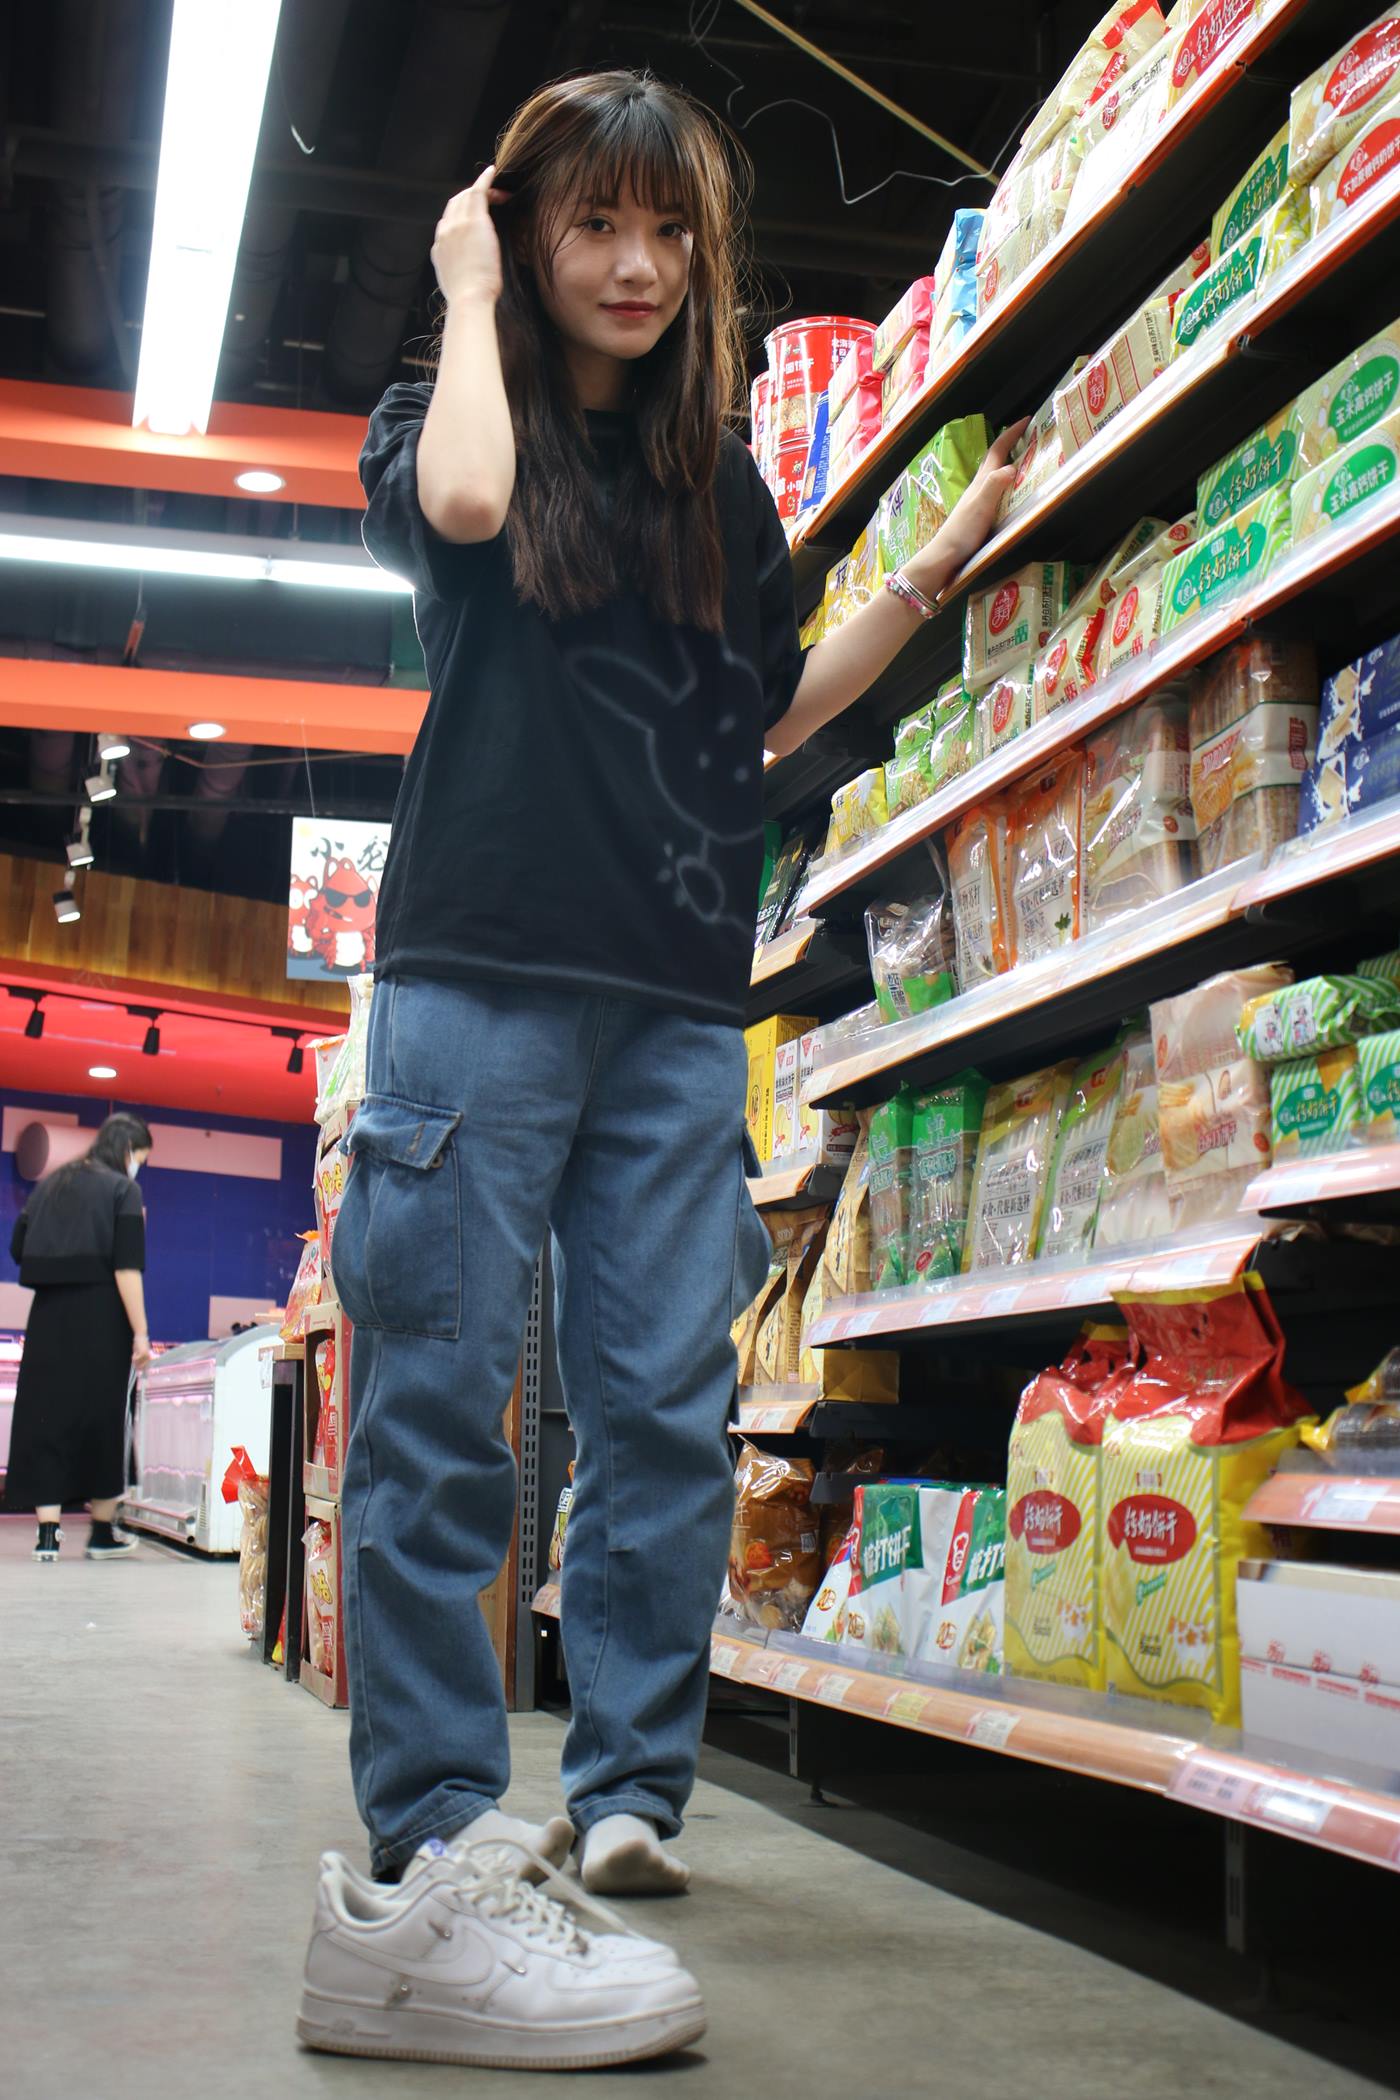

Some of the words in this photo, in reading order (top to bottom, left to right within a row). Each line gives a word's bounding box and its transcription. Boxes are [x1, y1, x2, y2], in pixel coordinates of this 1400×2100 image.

[1202, 252, 1256, 318] 钙奶饼干
[1336, 370, 1394, 427] 玉米高钙饼干
[1229, 442, 1283, 505] 钙奶饼干
[1330, 460, 1389, 514] 玉米高钙饼干
[1198, 532, 1252, 593] 钙奶饼干
[1024, 1501, 1063, 1537] 钙奶饼干
[1124, 1505, 1177, 1546] 钙奶饼干
